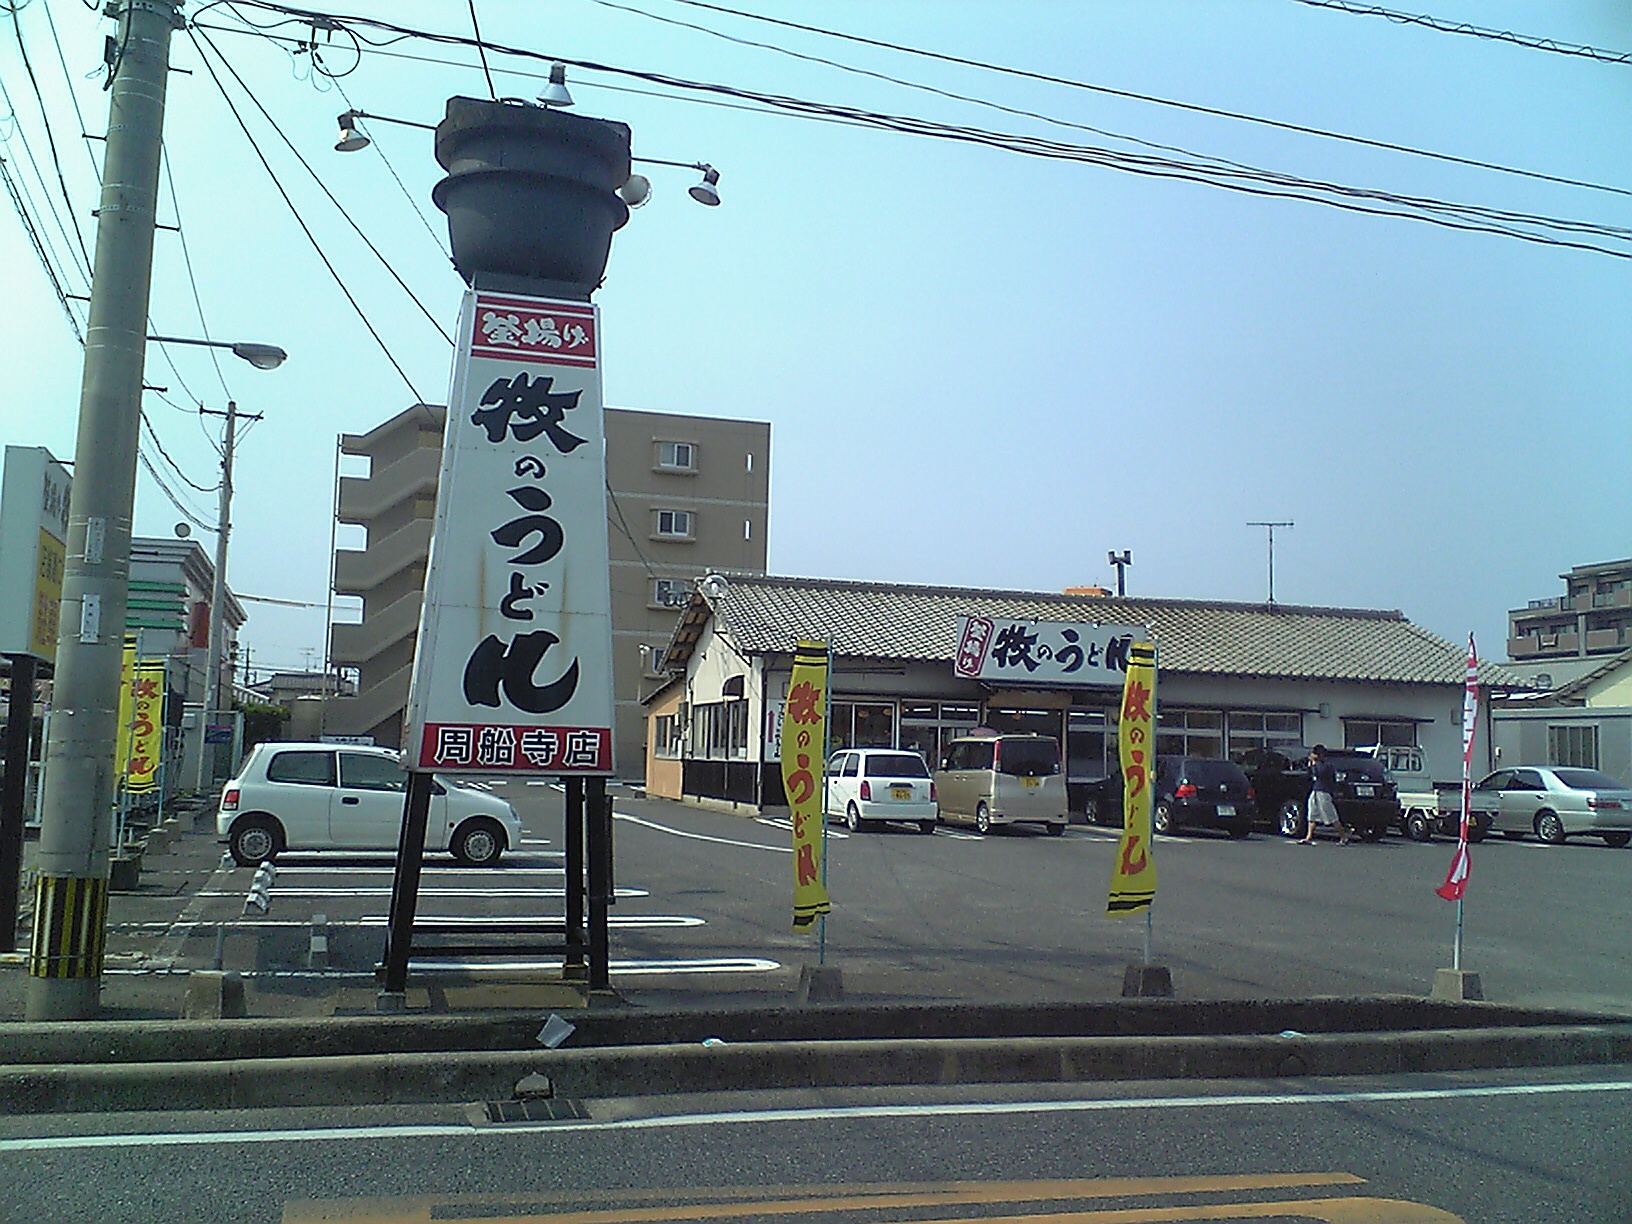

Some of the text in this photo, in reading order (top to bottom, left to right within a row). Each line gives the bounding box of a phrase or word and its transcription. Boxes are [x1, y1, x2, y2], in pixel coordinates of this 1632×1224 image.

[481, 311, 590, 349] 釜揚げ
[462, 371, 590, 714] 牧のうどん
[991, 623, 1133, 673] 牧のうどん
[129, 678, 160, 776] 牧のうどん
[434, 728, 600, 767] 周船寺店
[787, 680, 822, 887] 牧のうどん
